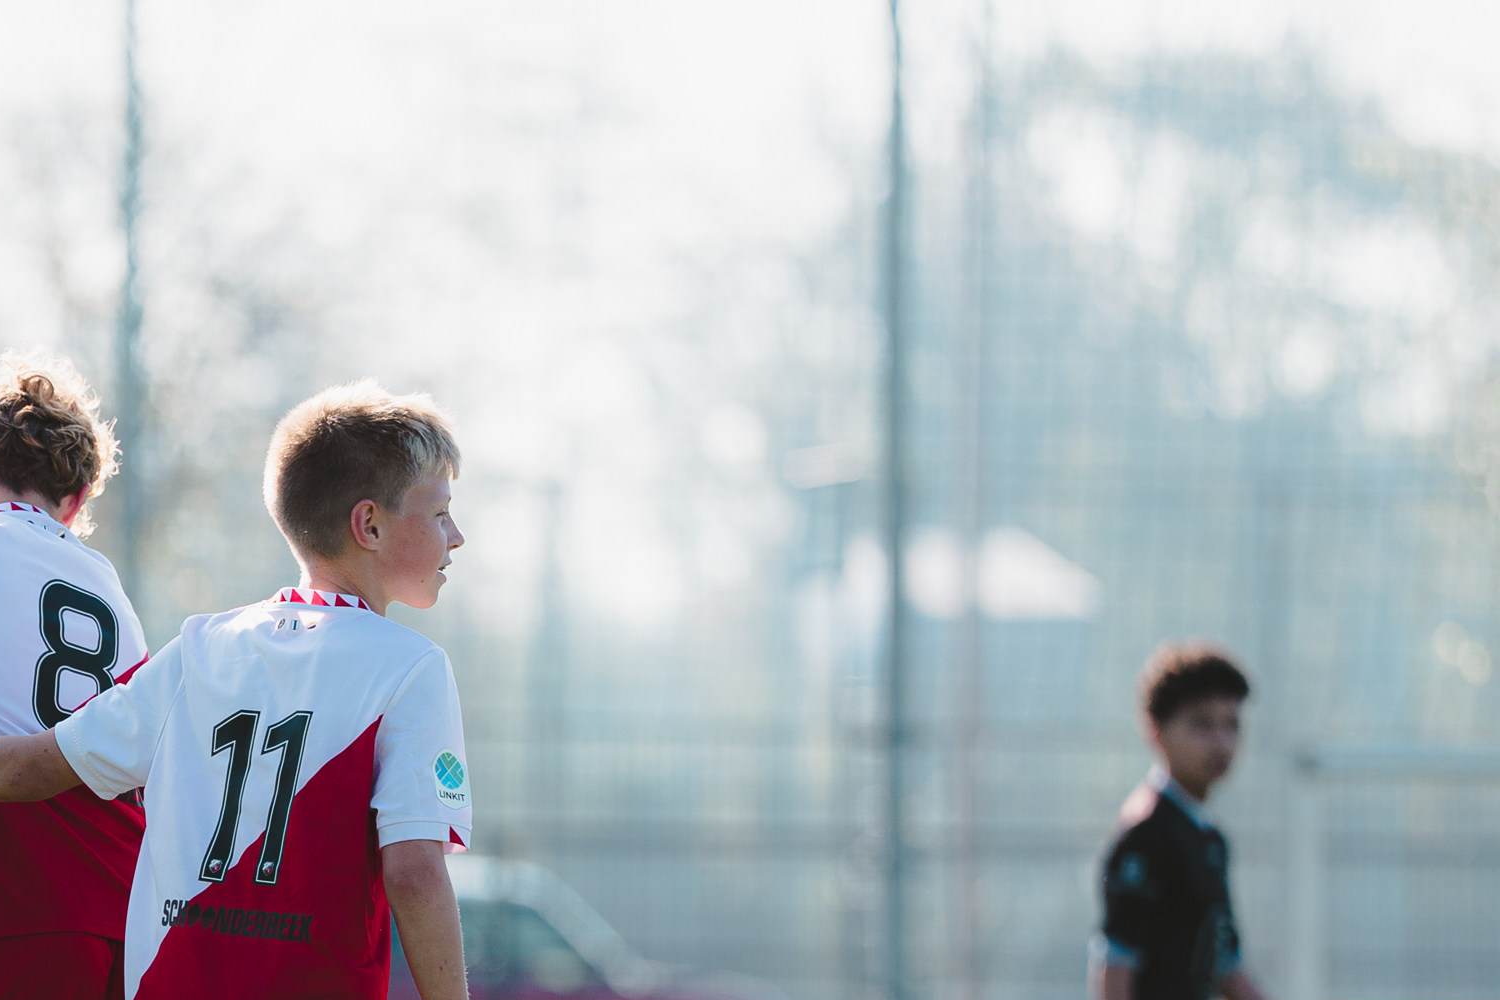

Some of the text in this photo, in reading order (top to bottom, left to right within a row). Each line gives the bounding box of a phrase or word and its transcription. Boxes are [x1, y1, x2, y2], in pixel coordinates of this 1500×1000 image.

[33, 579, 119, 730] 8
[199, 709, 313, 885] 11
[438, 789, 465, 801] LINKIT
